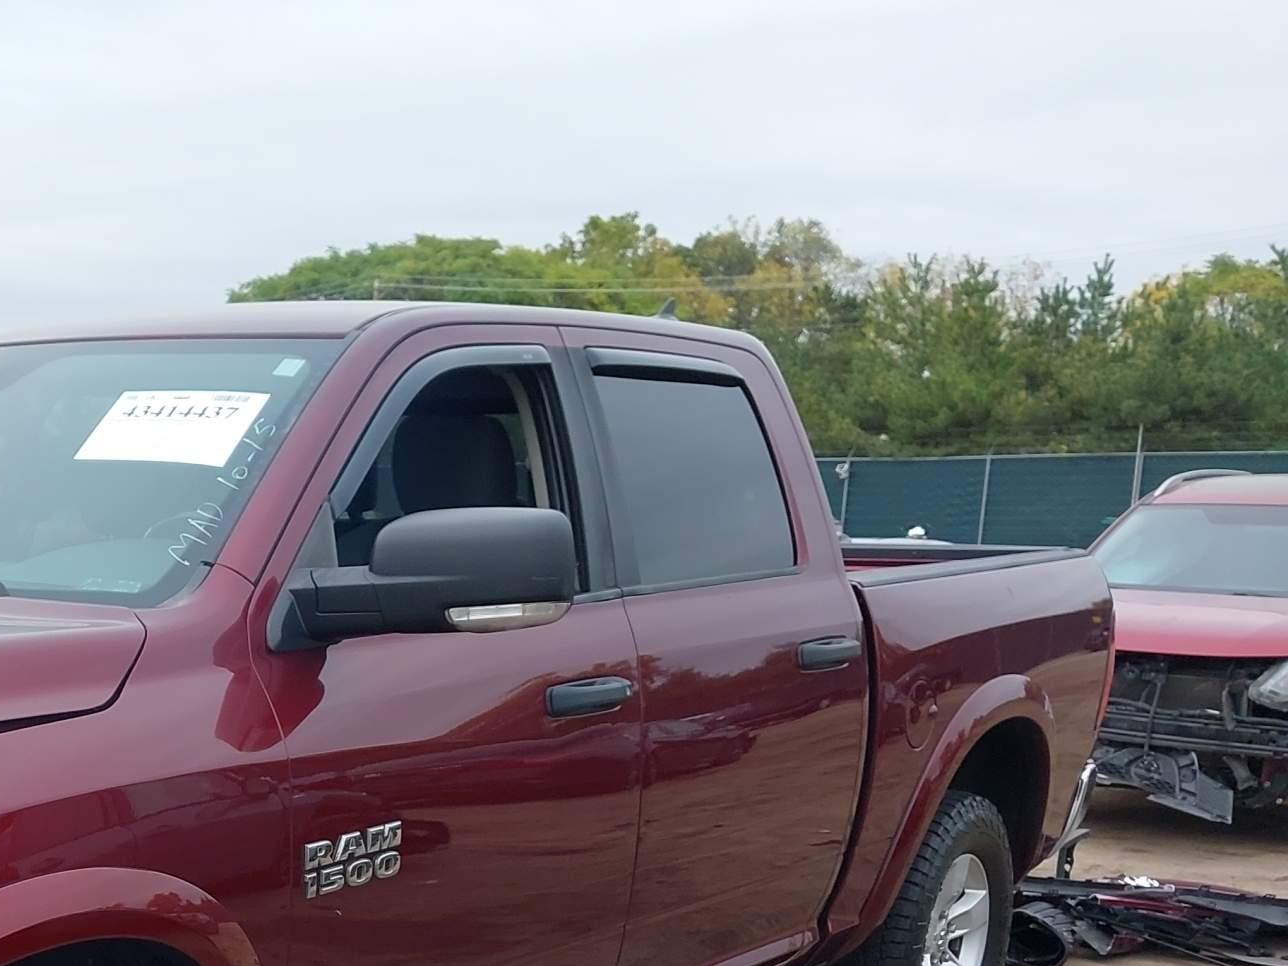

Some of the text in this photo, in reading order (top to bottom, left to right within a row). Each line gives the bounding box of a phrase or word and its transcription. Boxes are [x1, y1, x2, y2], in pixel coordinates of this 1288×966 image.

[122, 404, 240, 419] 43414437
[167, 502, 223, 566] MAD
[216, 417, 276, 490] 10-15
[304, 820, 402, 871] RAM
[304, 850, 401, 899] 1500
